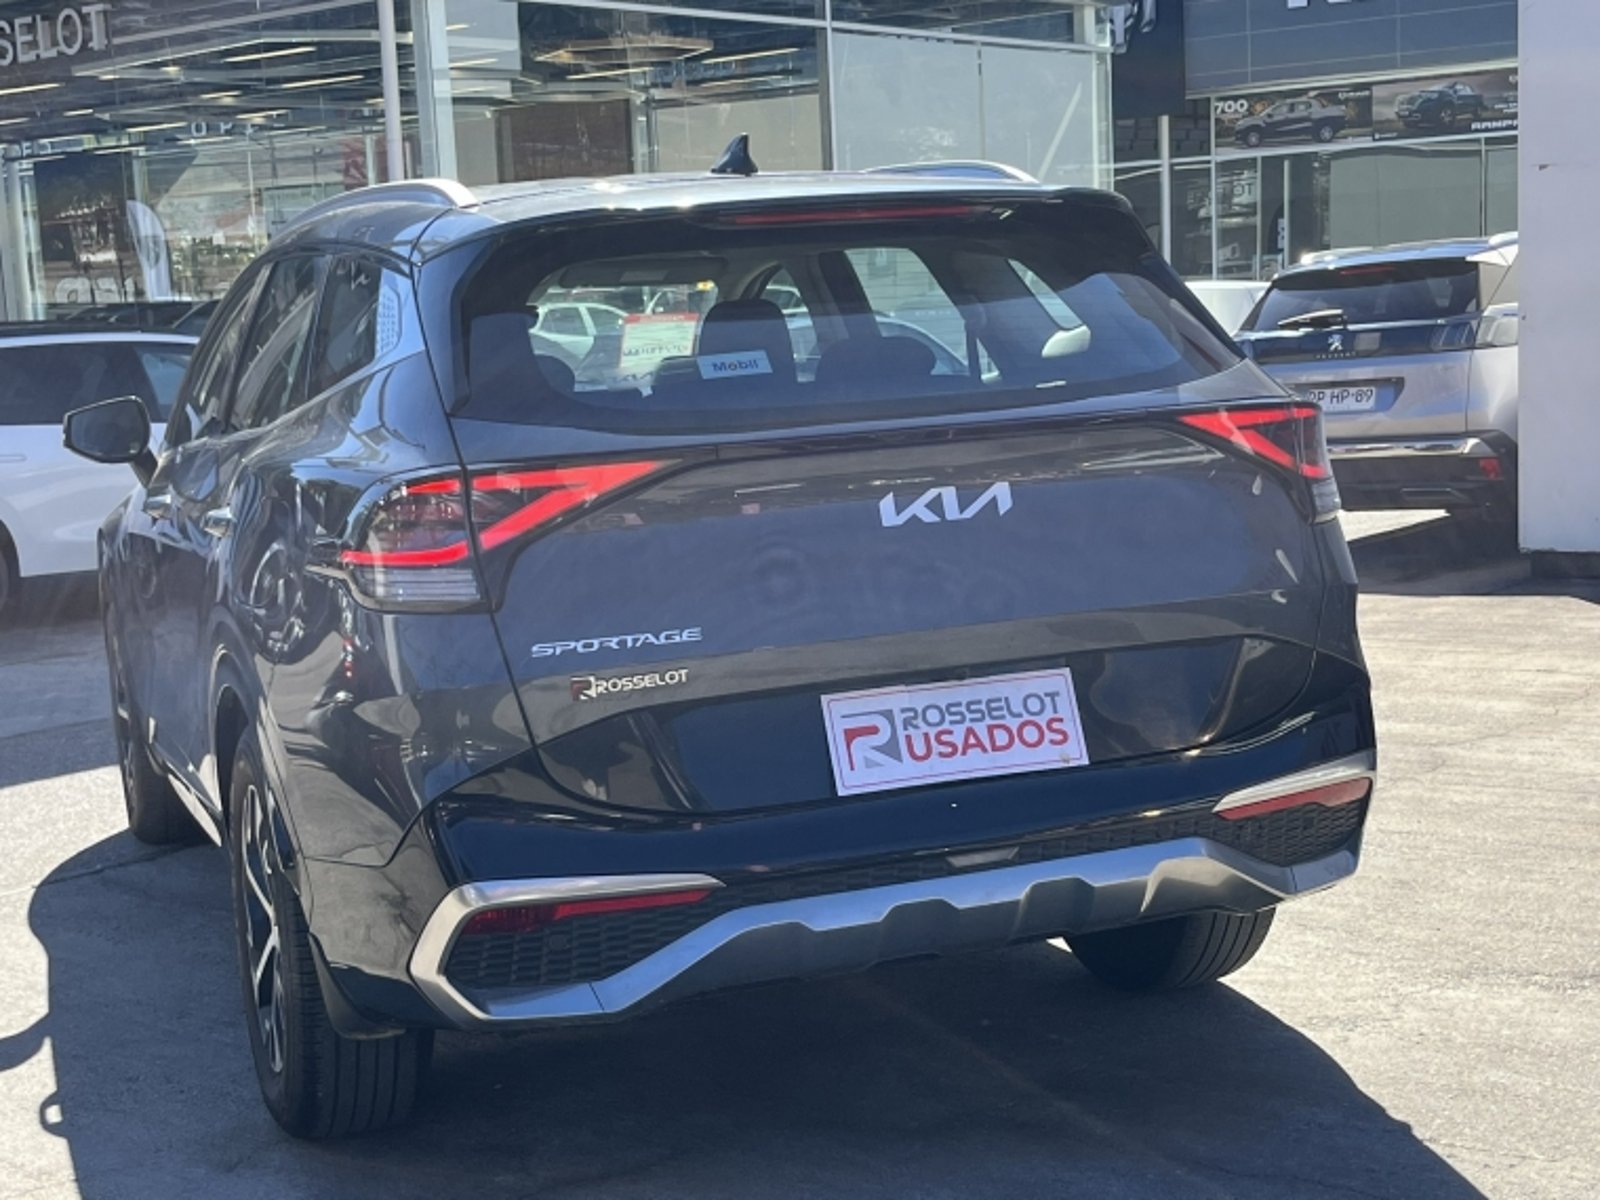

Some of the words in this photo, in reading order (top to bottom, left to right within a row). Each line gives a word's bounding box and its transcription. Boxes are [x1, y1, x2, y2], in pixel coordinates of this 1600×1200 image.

[1214, 99, 1249, 115] 700
[712, 359, 760, 373] Mobil
[879, 481, 1013, 527] KIA
[531, 627, 703, 658] SPORTAGE
[595, 669, 689, 694] ROSSELOT
[899, 691, 1061, 732] ROSSELOT
[904, 716, 1069, 763] USADOS
